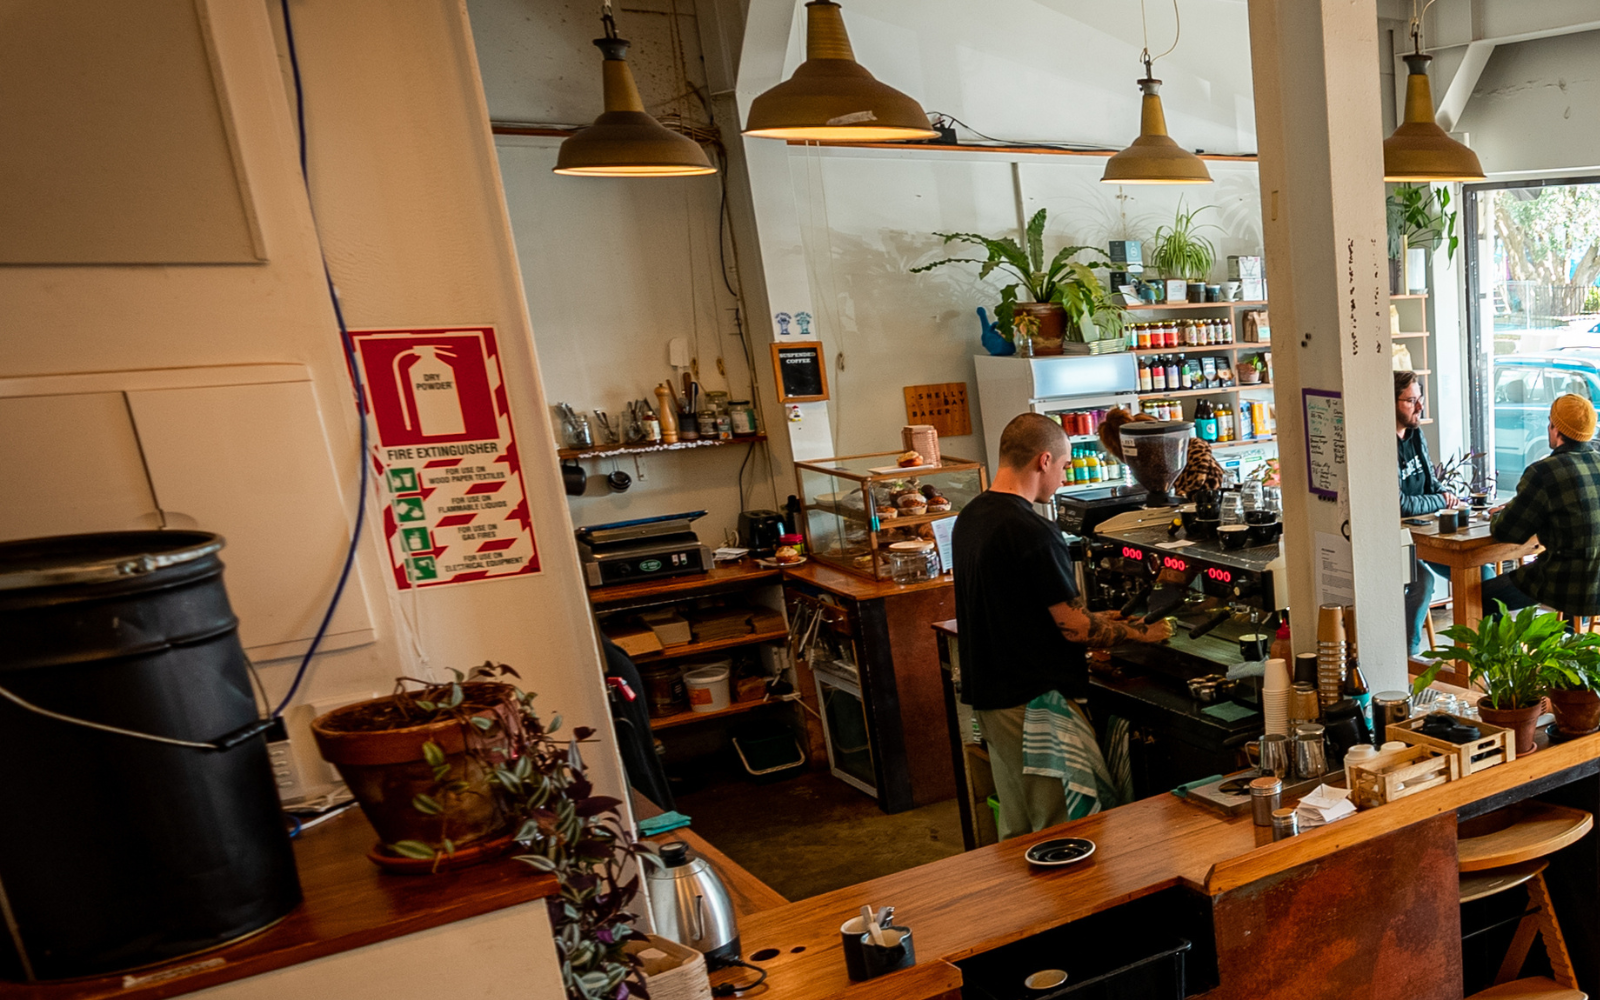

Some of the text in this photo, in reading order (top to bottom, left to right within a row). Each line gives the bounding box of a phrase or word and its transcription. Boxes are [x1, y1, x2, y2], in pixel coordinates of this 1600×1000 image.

[424, 373, 440, 382] DRY
[416, 382, 452, 390] POWDER
[918, 390, 963, 400] SHELLY
[944, 398, 964, 406] BAY
[912, 408, 950, 418] BAKER
[388, 443, 498, 460] FIRE EXTINGUISHER
[461, 466, 474, 474] USE
[429, 472, 505, 484] WOOD PAPER TEXTILES
[452, 496, 466, 504] FOR
[482, 494, 492, 502] ON
[438, 500, 508, 514] FLAMMABLE LIQUIDS
[474, 524, 486, 532] USE
[462, 530, 496, 541] GAS FIRES
[464, 554, 478, 562] FOR
[444, 556, 523, 572] ELECTRICAL EQUIPMENT
